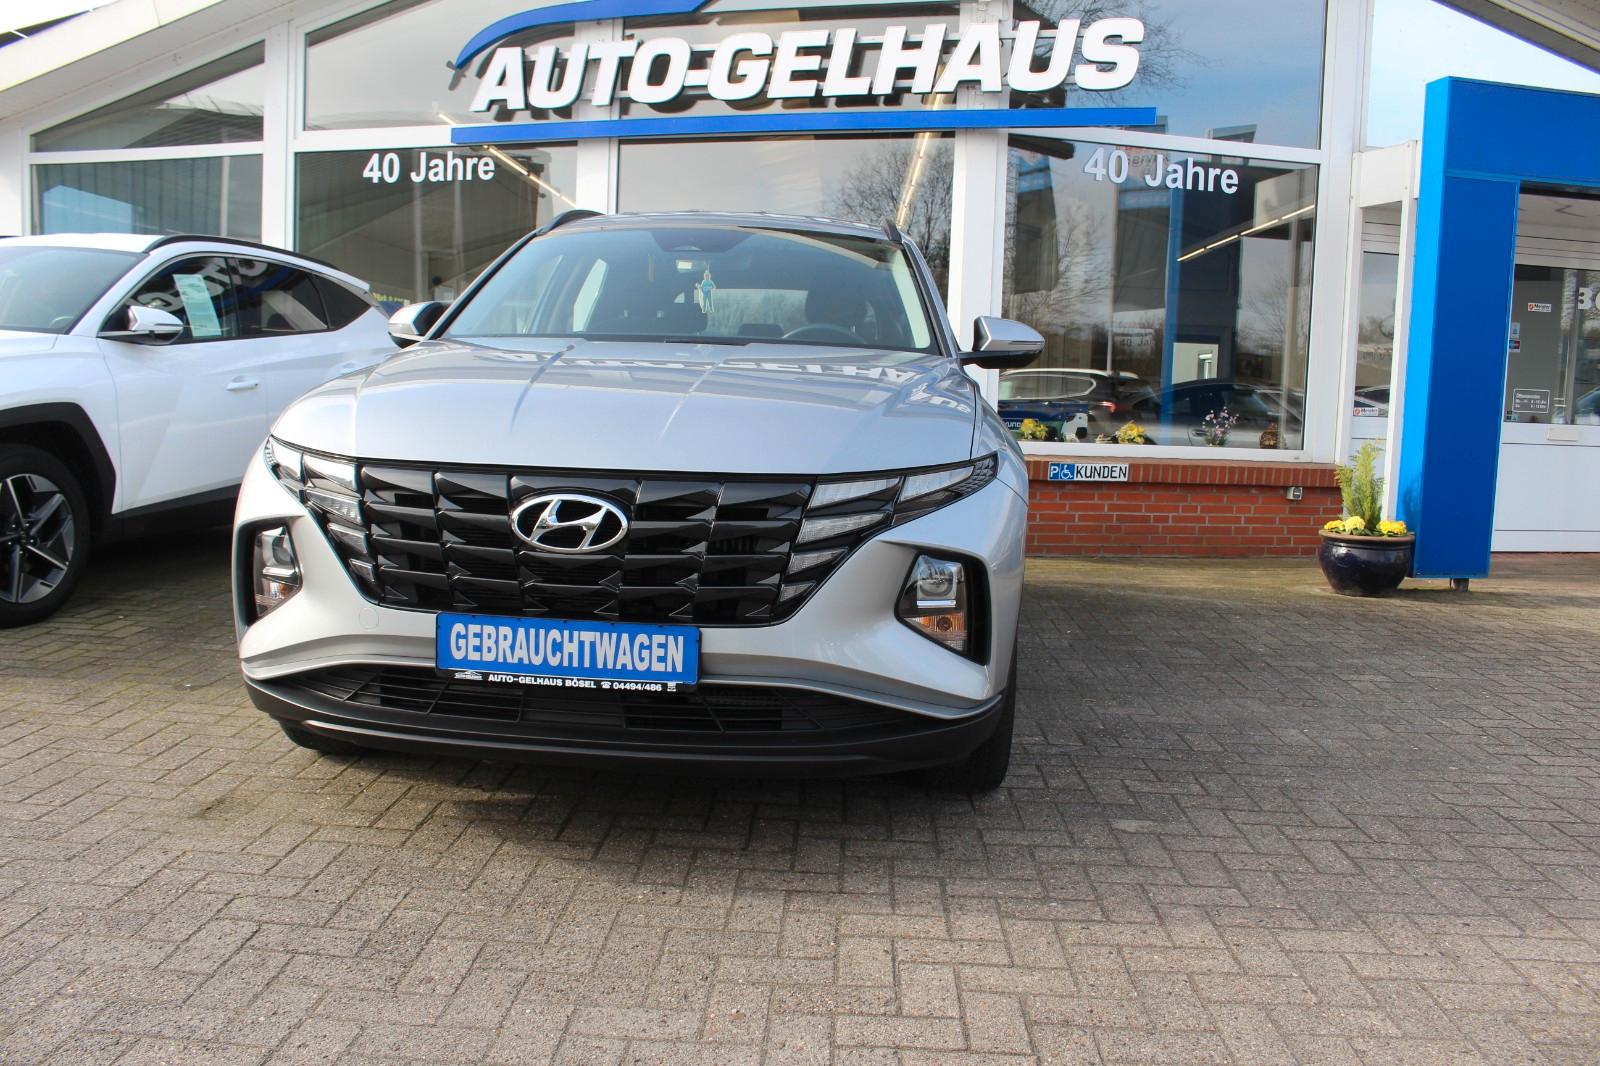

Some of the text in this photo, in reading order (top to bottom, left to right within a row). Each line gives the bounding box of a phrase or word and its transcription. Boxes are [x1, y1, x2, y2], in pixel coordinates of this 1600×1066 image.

[469, 17, 1145, 112] AUTO-GELHAUS
[362, 150, 496, 183] 40 Jahre
[1084, 147, 1129, 184] 40
[1144, 154, 1239, 194] Jahre
[1075, 464, 1128, 479] KUNDEN
[450, 623, 684, 673] GEBRAUCHTWAGEN
[488, 673, 563, 687] AUTO-GELHAUS
[565, 677, 597, 689] BÖSEL
[613, 681, 662, 692] 04494/486
